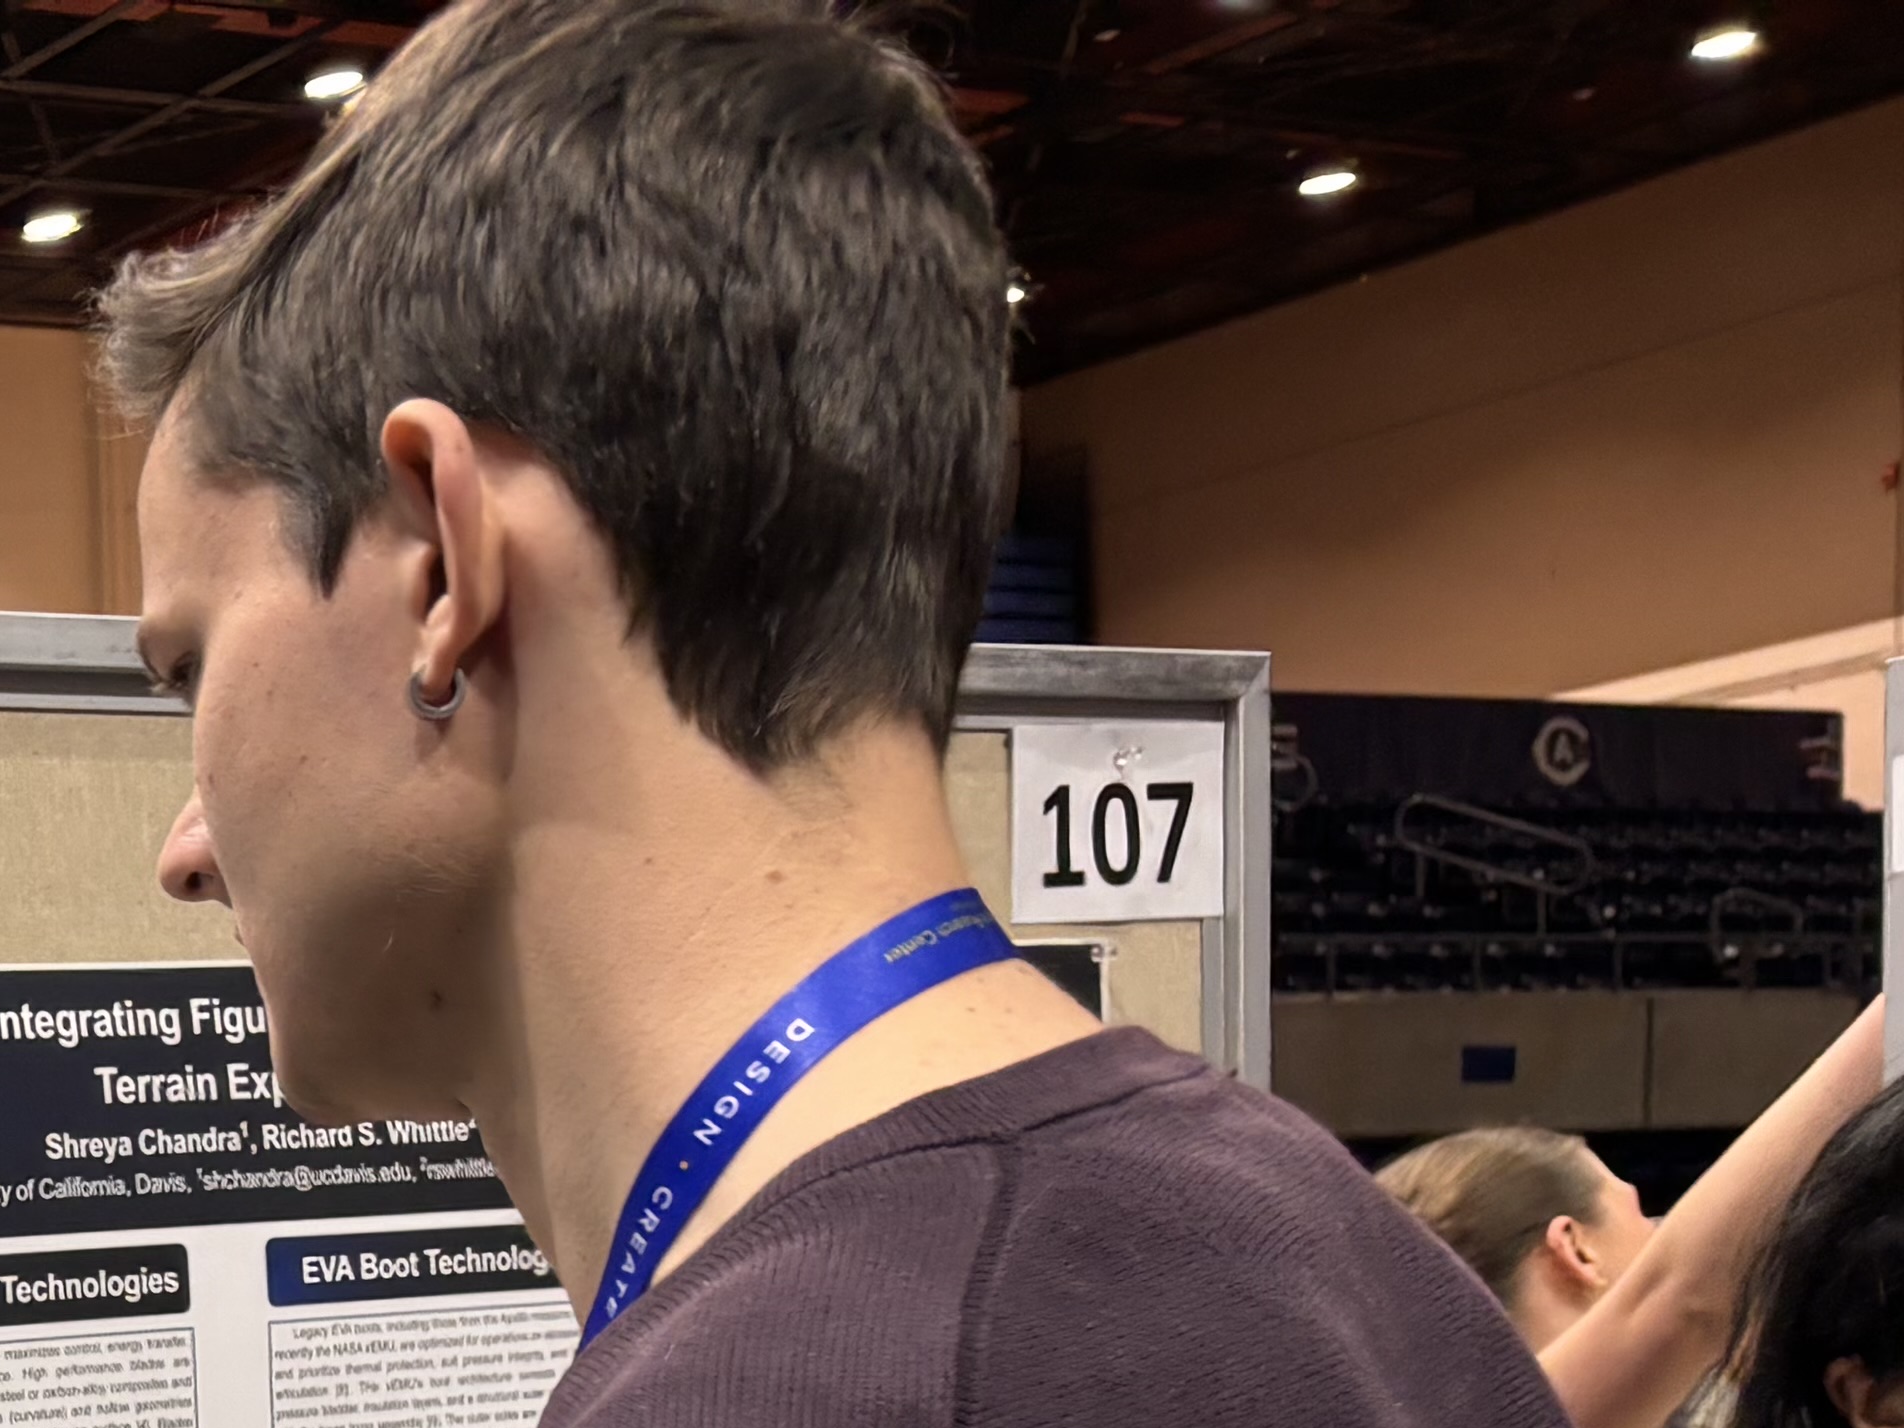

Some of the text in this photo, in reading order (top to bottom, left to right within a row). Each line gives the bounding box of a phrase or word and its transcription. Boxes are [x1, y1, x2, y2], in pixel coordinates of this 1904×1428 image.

[1042, 781, 1192, 888] 107
[94, 1064, 217, 1104] Terrain
[46, 1132, 132, 1162] Shreya
[262, 1123, 352, 1150] Richard
[358, 1122, 381, 1147] S.
[606, 1018, 816, 1318] DESIGN CREATE
[0, 1266, 180, 1305] Technologies
[302, 1255, 354, 1284] EVA
[360, 1250, 418, 1279] Boot
